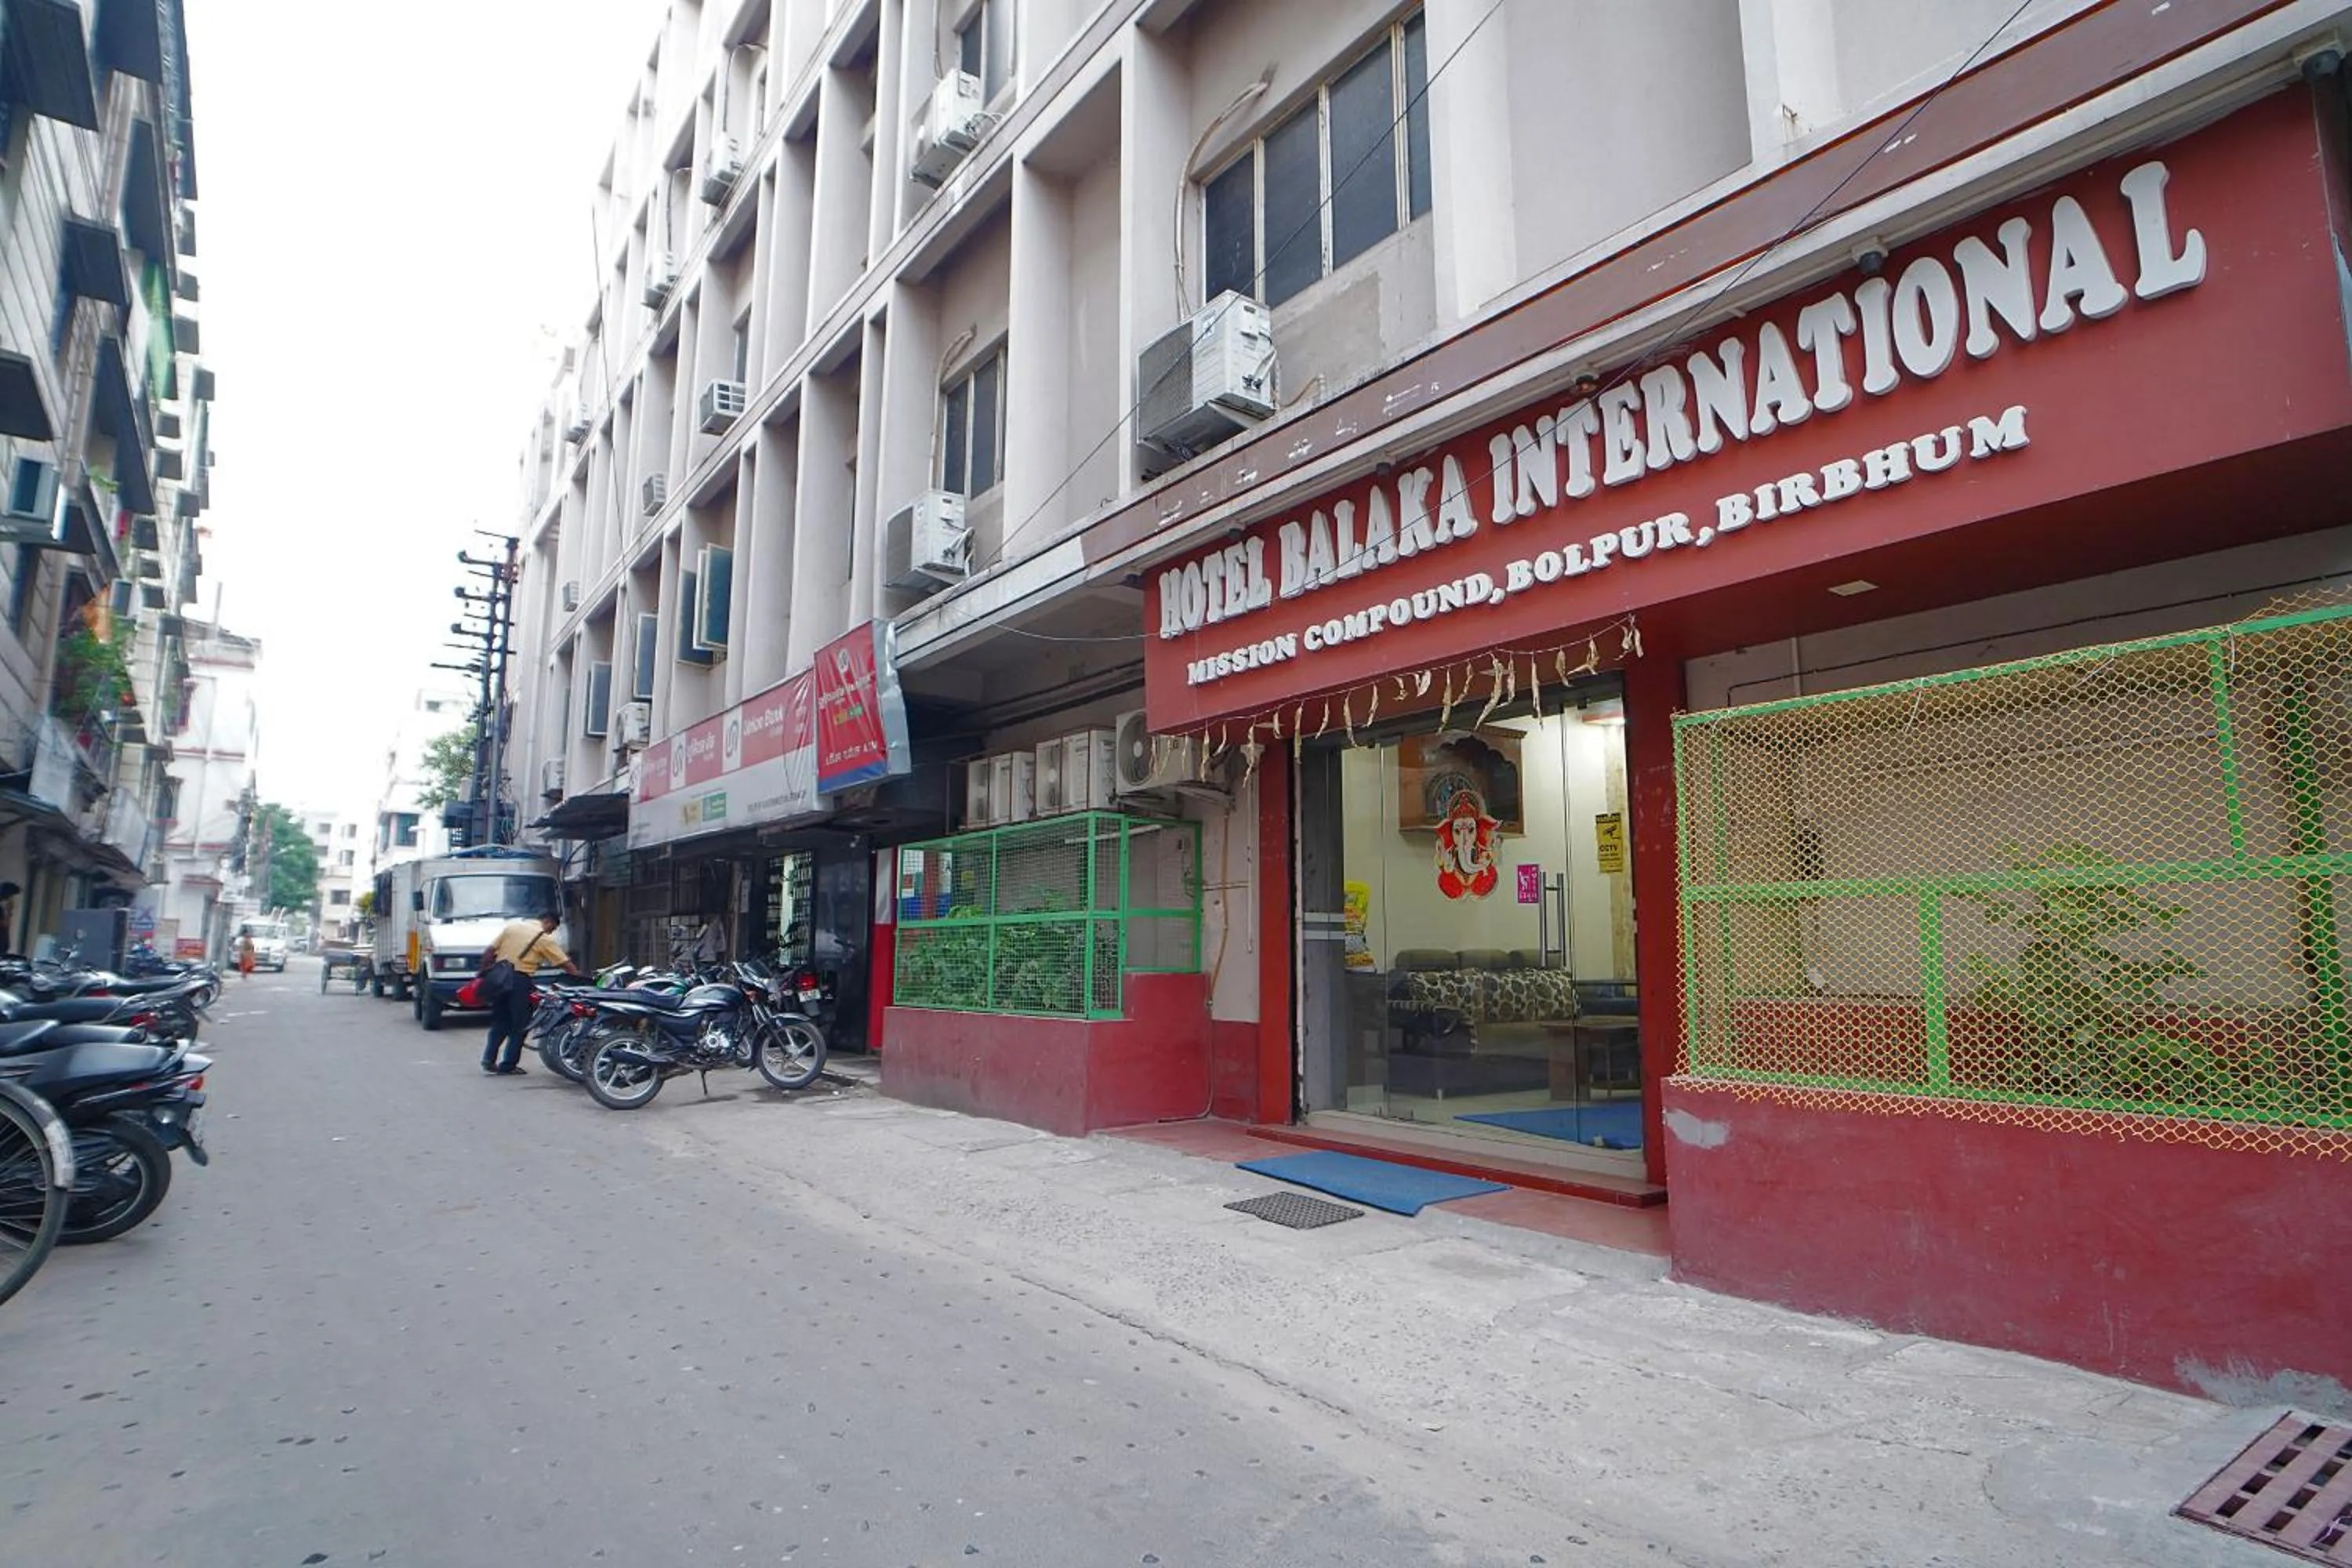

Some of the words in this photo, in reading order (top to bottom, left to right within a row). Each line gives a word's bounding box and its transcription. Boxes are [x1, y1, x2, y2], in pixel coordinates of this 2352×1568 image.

[1159, 536, 1274, 640] HOTEL
[1278, 452, 1480, 600] BALAKA
[1490, 160, 2209, 526] INTERNATIONAL
[1186, 632, 1299, 687] MISSION
[1715, 404, 2032, 535] BIRBHUM
